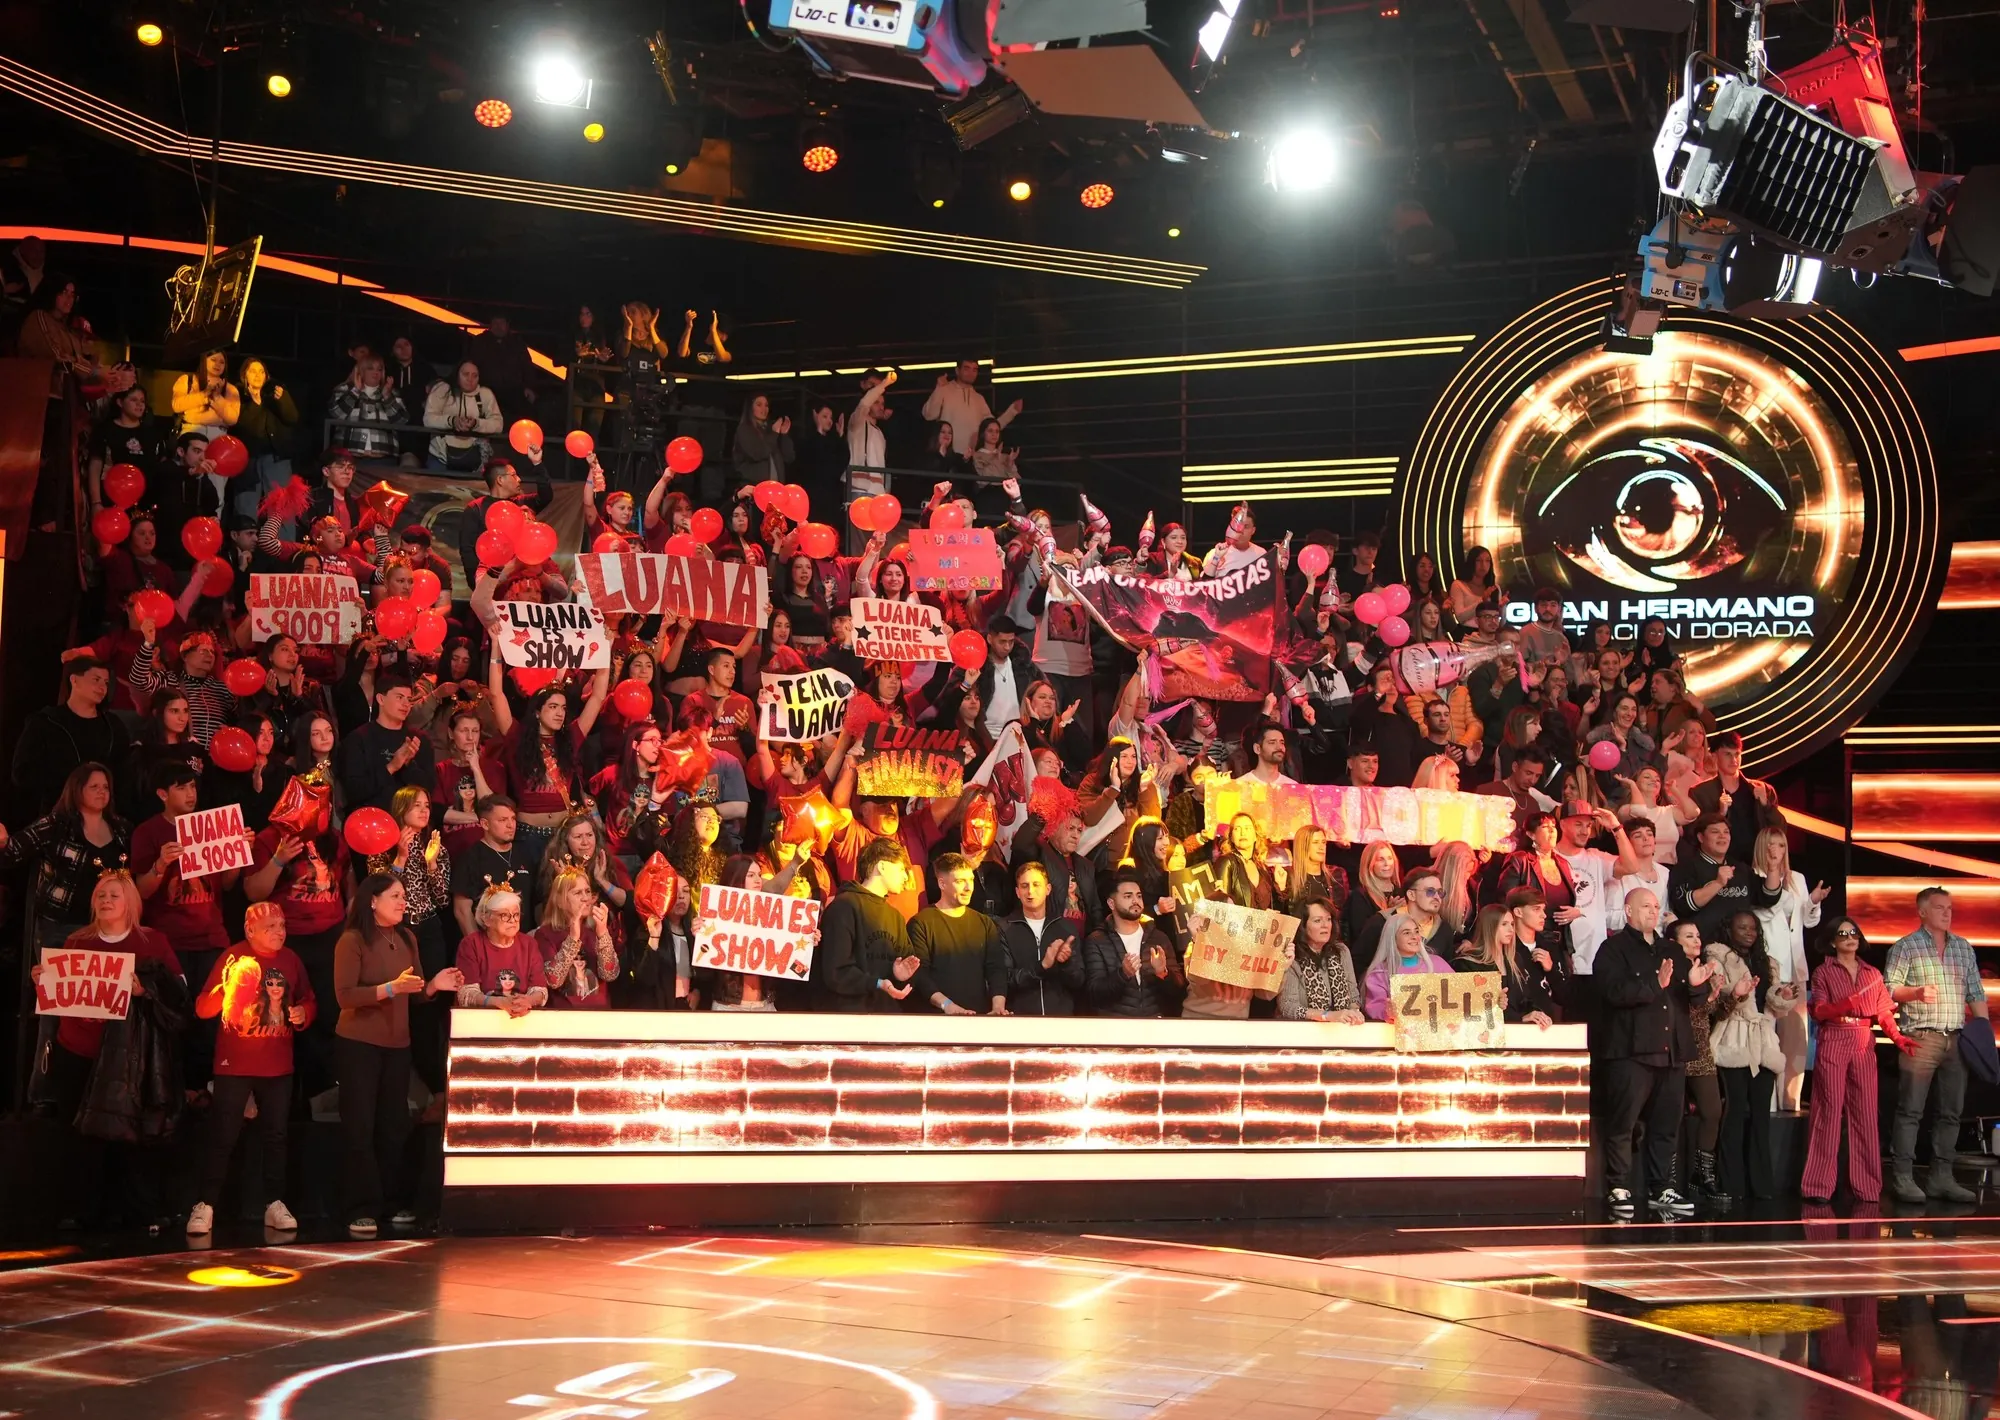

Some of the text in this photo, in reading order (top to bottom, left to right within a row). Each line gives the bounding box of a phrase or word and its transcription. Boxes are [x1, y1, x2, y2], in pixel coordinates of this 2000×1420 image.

[795, 6, 838, 24] L10-C
[250, 575, 356, 609] LUANA AL
[578, 552, 758, 628] LUANA
[508, 602, 592, 629] LUANA
[863, 601, 931, 628] LUANA
[1506, 596, 1814, 623] GAN HERMANO
[271, 610, 341, 645] 9009
[541, 627, 564, 644] ES
[874, 625, 922, 643] TIENE
[1690, 620, 1814, 640] DORADA
[524, 640, 585, 669] SHOW
[855, 640, 948, 661] AGUANTE
[778, 673, 834, 704] TEAM
[769, 698, 848, 739] LUANA
[874, 721, 960, 751] LUANA
[178, 807, 244, 847] LUANA
[181, 840, 249, 874] AL 9009
[700, 887, 819, 934] LUANA ES
[47, 953, 124, 980] TEAM
[710, 933, 794, 975] SHOW
[1203, 944, 1279, 974] BY ZILLI
[36, 980, 128, 1016] LUANA
